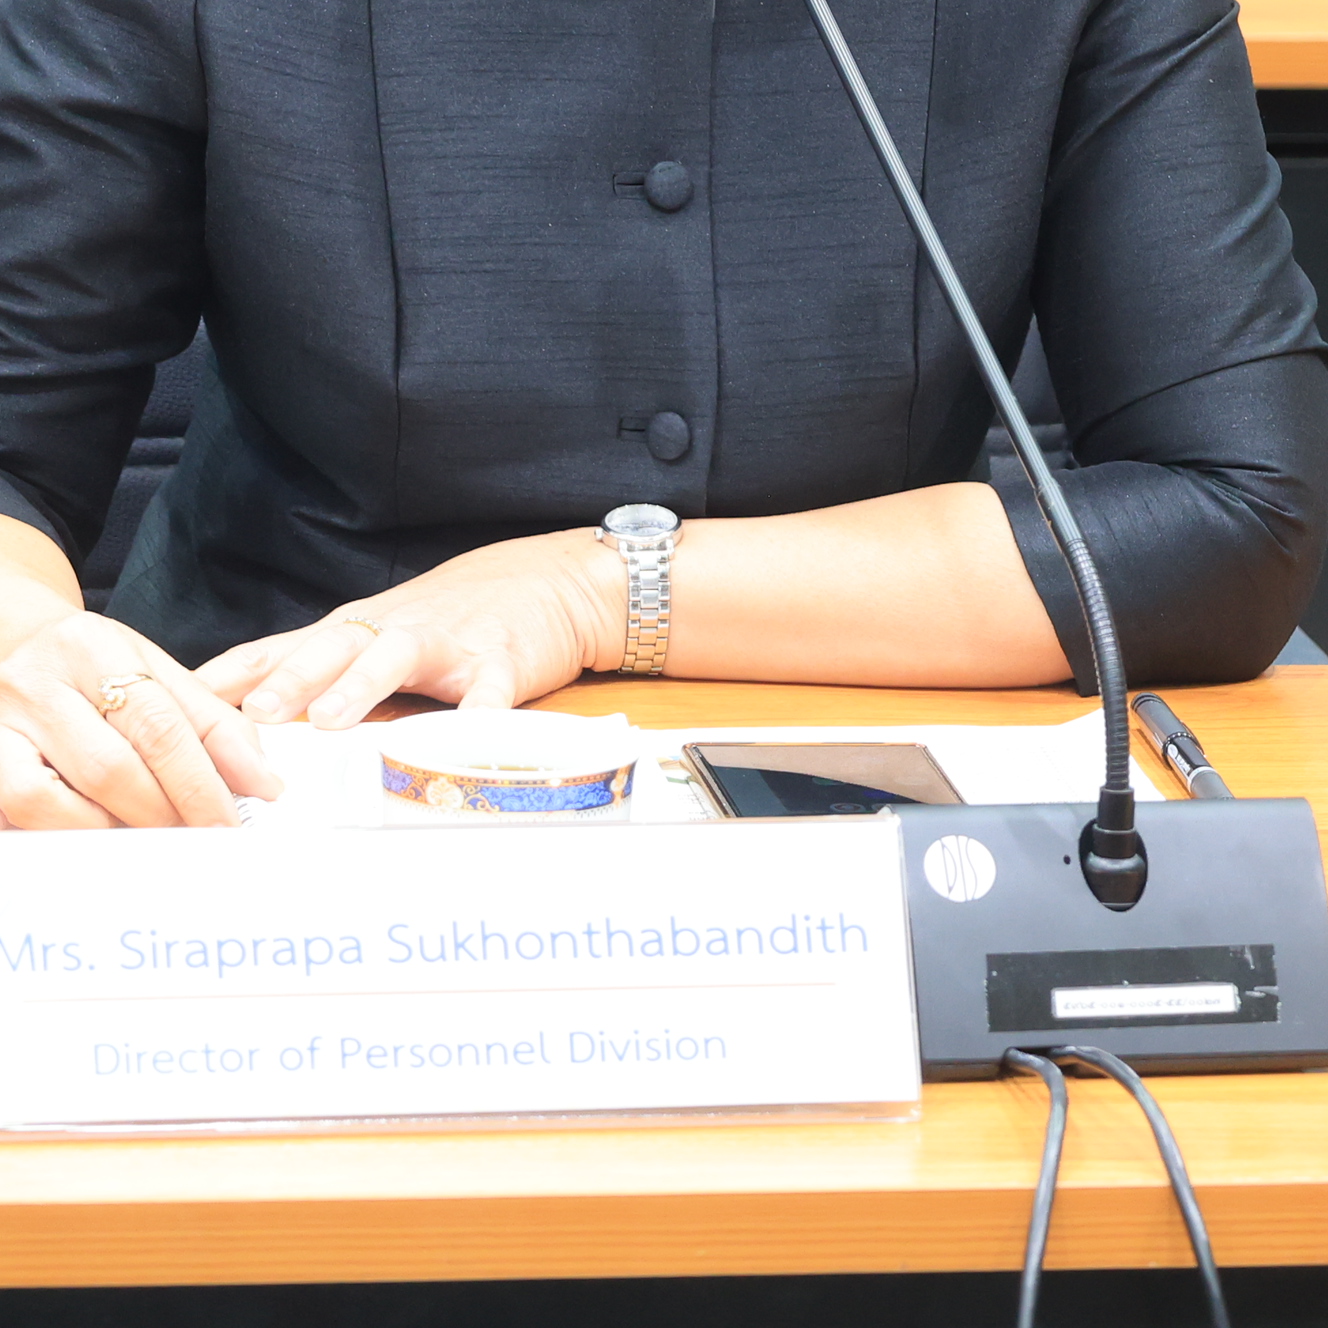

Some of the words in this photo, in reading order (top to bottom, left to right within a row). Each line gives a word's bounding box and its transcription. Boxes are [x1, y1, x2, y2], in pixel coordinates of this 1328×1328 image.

[119, 928, 364, 979] Siraprapa
[386, 911, 869, 964] Sukhonthabandith
[92, 1041, 259, 1076] Director
[278, 1035, 322, 1072] of
[340, 1029, 551, 1070] Personnel
[568, 1027, 727, 1064] Division
